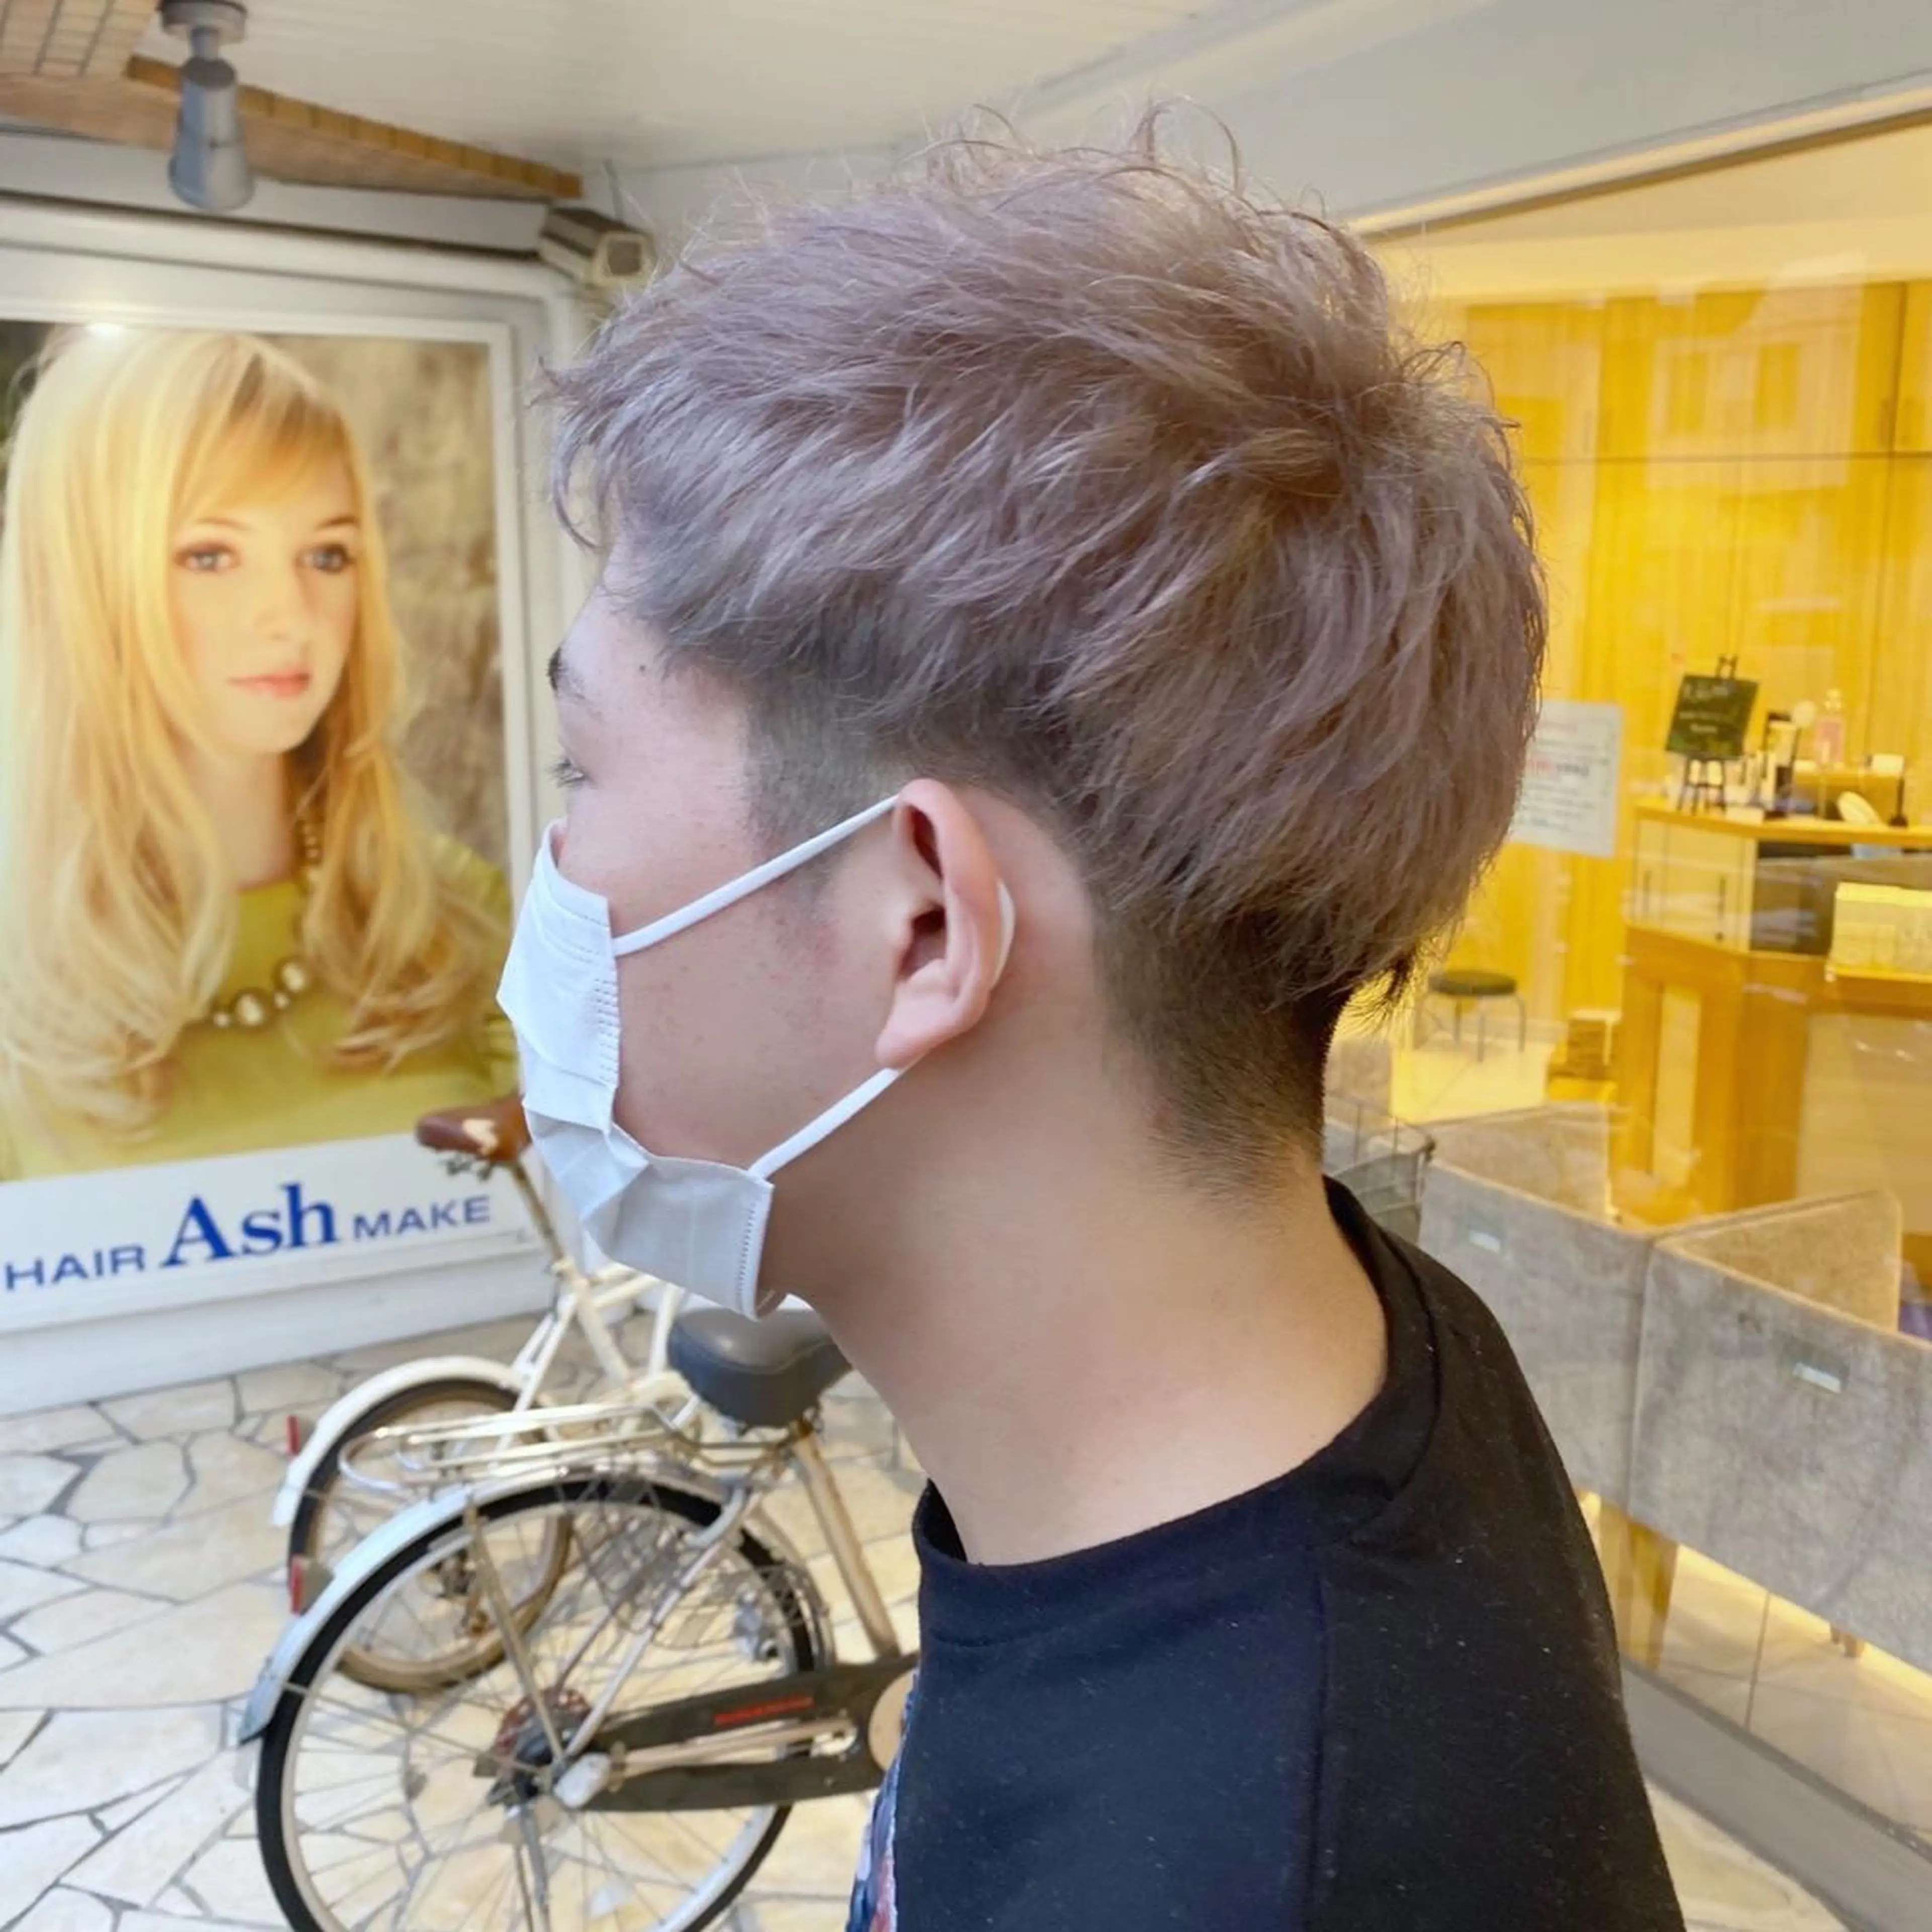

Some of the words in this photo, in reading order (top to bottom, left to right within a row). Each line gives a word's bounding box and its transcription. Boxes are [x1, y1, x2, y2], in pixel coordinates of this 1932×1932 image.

[5, 1245, 145, 1291] HAIR
[160, 1182, 338, 1269] Ash
[353, 1195, 491, 1241] MAKE
